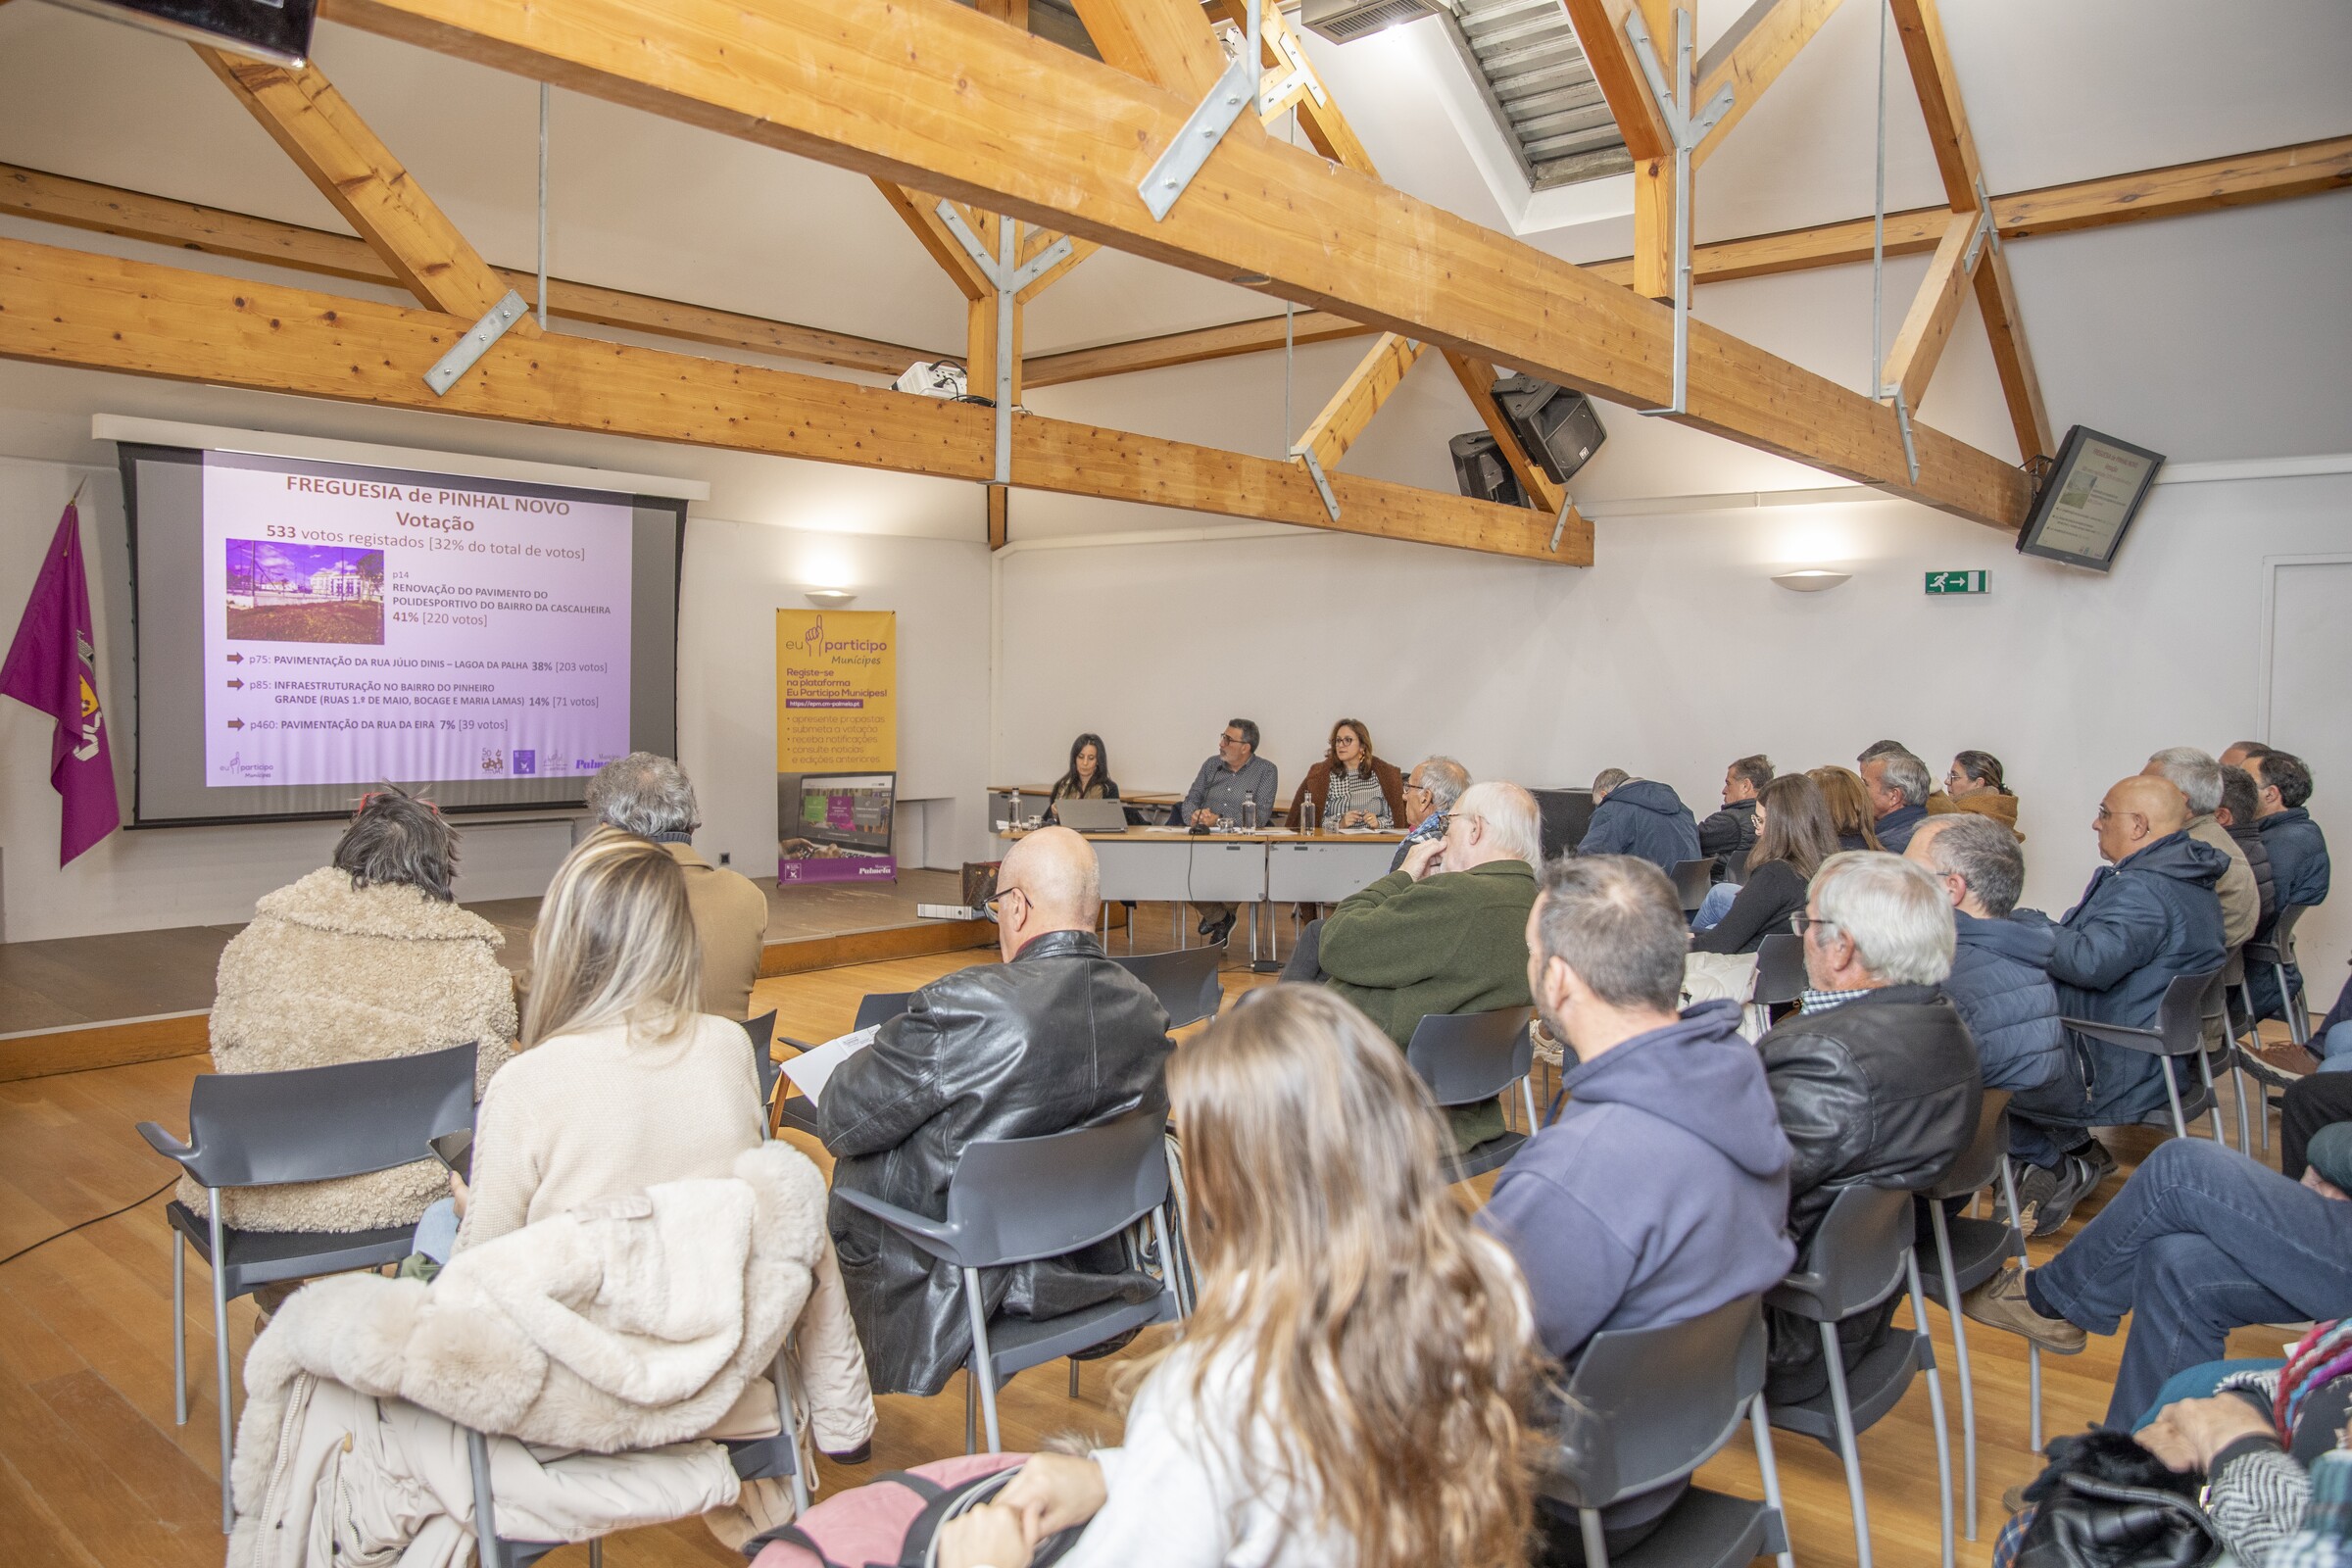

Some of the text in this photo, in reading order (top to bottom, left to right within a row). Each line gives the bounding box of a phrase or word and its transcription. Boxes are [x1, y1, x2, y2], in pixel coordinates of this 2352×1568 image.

[286, 475, 570, 515] FREGUESIA de PINHAL NOVO
[396, 512, 474, 533] Votação
[267, 525, 586, 562] 533 votos registados [32% do total de votos]
[392, 583, 455, 596] RENOVAÇÃO
[475, 588, 531, 599] PAVIMENTO
[392, 597, 477, 610] POLIDESPORTIVO
[497, 602, 532, 612] BAIRRO
[551, 605, 611, 614] CASCALHEIRA
[393, 612, 488, 627] 41% [220 votos]
[786, 640, 887, 653] eu participo
[249, 656, 270, 664] p75:
[274, 656, 352, 667] PAVIMENTAÇÃO
[393, 658, 418, 667] JÚLIO
[532, 662, 552, 671] 38%
[556, 662, 576, 673] [203
[579, 662, 608, 673] votos]
[832, 655, 881, 667] Munícipes
[787, 668, 834, 678] Registe-se
[250, 681, 271, 691] p85:
[274, 681, 381, 692] INFRAESTRUTURAÇÃO
[800, 679, 851, 688] plataforma
[801, 689, 840, 698] Participo
[274, 695, 317, 704] GRANDE
[320, 696, 349, 706] (RUAS
[382, 697, 411, 706] MAIO,
[492, 697, 524, 706] LAMAS)
[529, 697, 549, 707] 14%
[553, 697, 566, 708] [71
[570, 698, 599, 708] votos]
[250, 720, 277, 731] p460:
[281, 718, 359, 730] PAVIMENTAÇÃO
[440, 720, 455, 729] 7%
[459, 720, 474, 731] [39
[477, 720, 509, 731] votos]
[800, 756, 834, 764] edições
